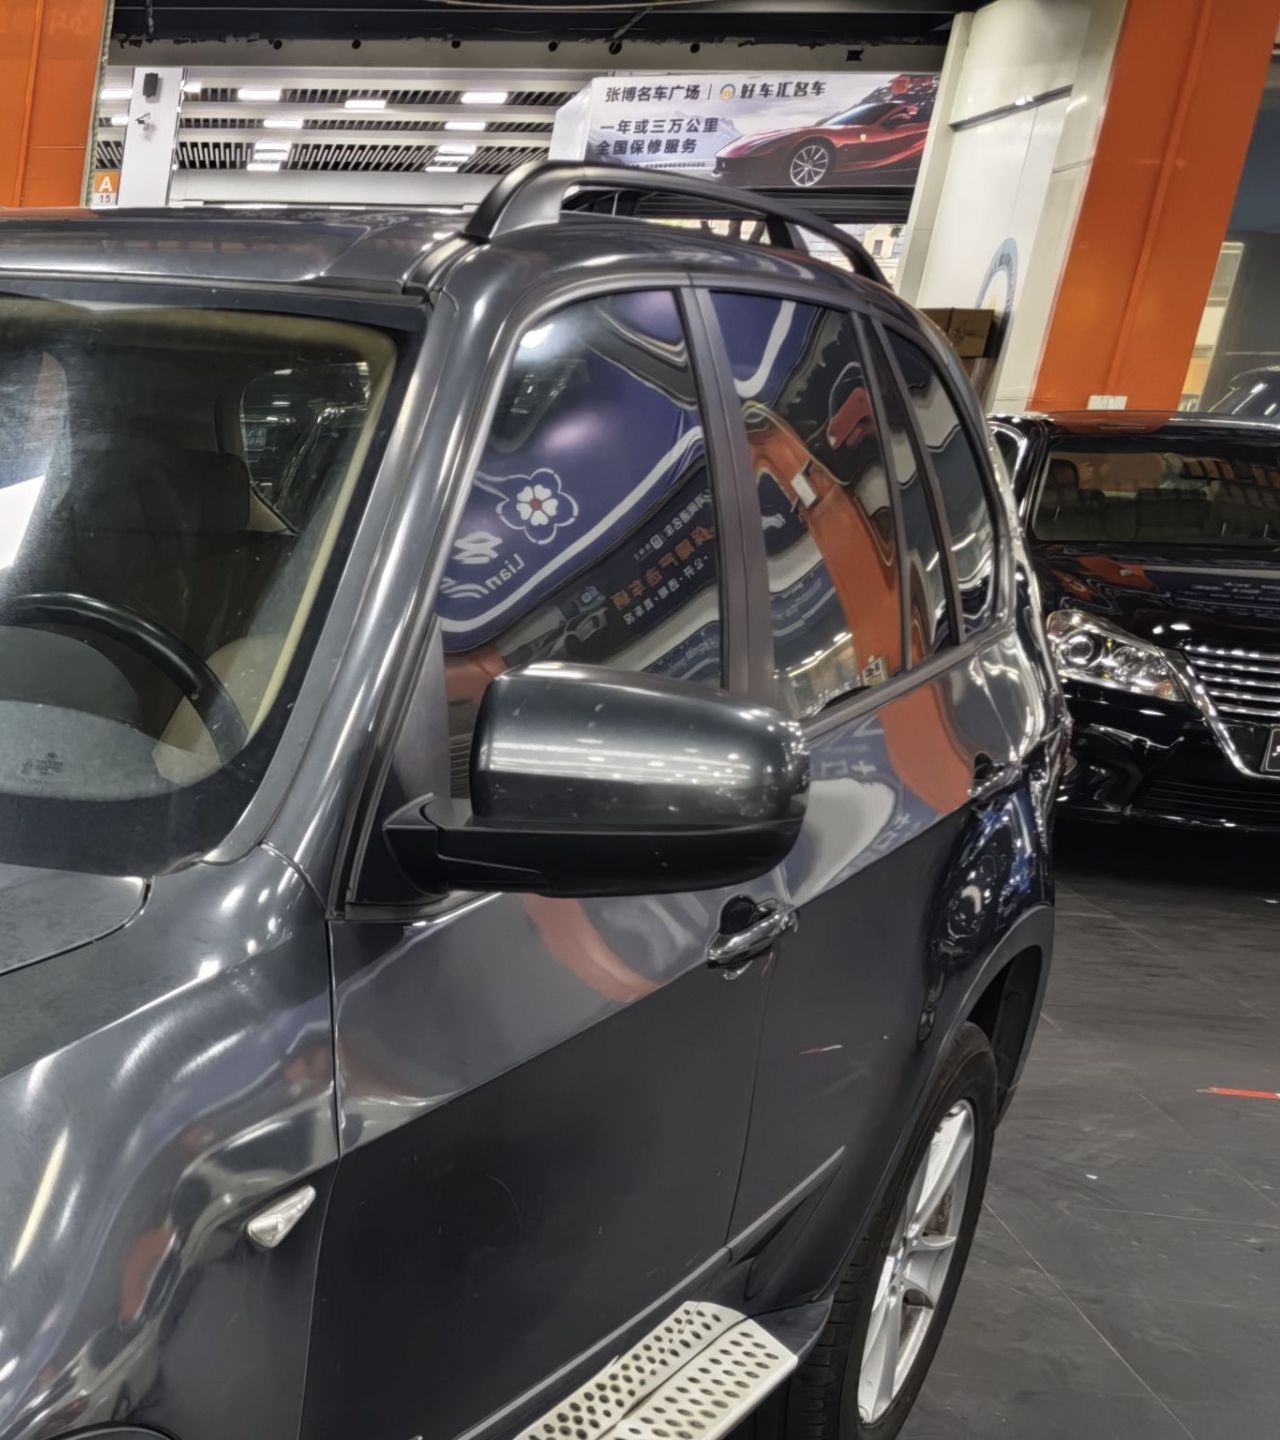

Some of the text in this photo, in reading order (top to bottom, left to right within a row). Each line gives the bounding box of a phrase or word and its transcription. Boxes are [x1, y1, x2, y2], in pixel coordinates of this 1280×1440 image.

[606, 85, 701, 102] 张博名车广场
[601, 117, 720, 134] 一年或三万公里
[595, 139, 698, 156] 全国保修服务
[99, 176, 112, 192] A
